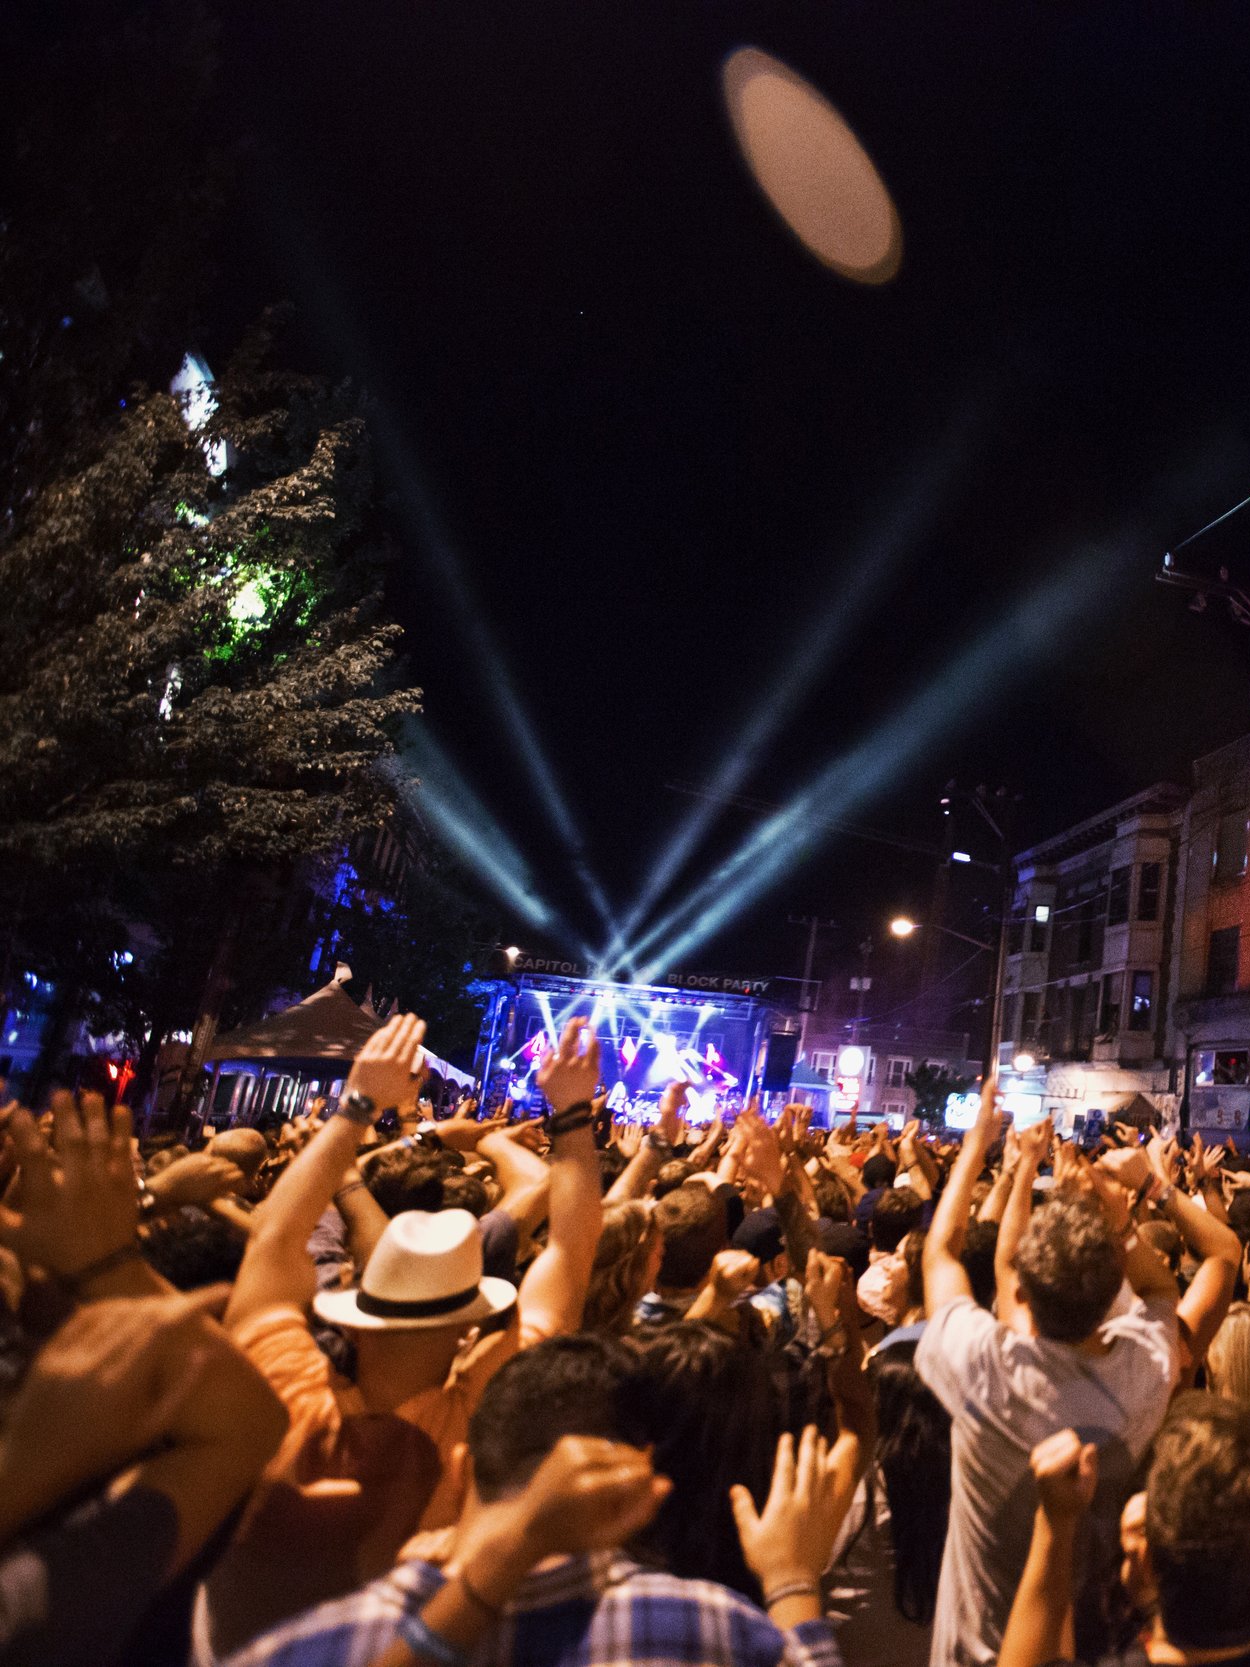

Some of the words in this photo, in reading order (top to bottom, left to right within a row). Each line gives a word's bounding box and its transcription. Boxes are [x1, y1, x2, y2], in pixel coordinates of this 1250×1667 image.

[513, 956, 581, 974] CAPITOL
[667, 973, 719, 988] BLOCK
[722, 978, 770, 992] PARTY
